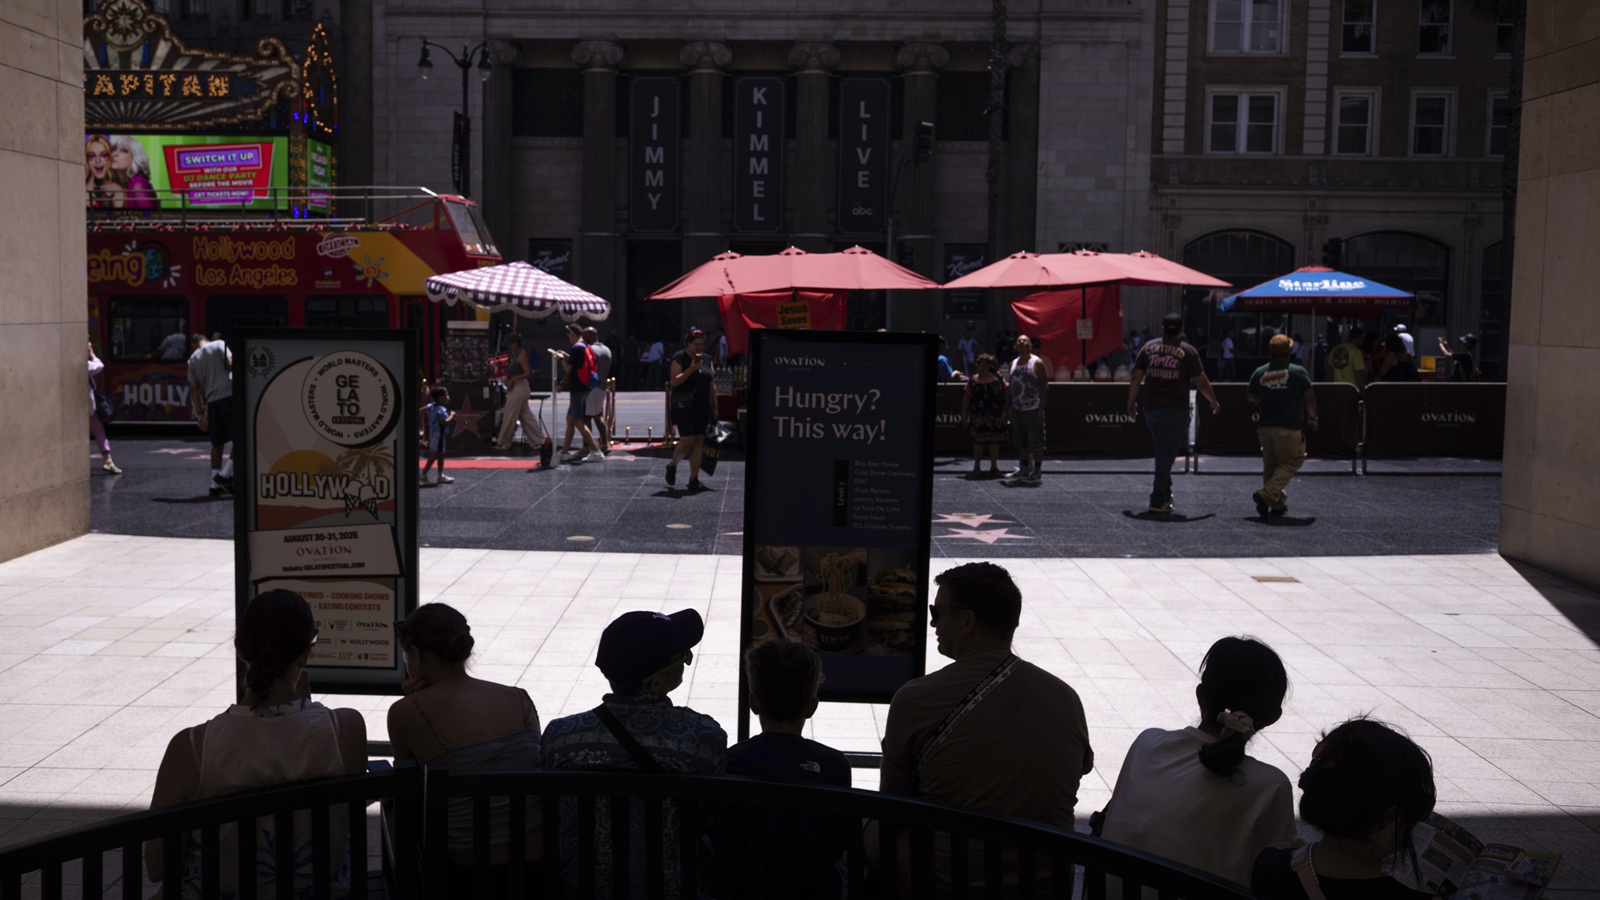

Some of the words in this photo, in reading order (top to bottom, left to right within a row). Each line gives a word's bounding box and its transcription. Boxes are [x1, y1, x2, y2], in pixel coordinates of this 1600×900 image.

[645, 95, 664, 210] JIMMY
[856, 100, 872, 188] LIVE
[185, 154, 225, 165] SWITCH
[227, 153, 237, 161] IT
[240, 152, 254, 161] UP
[749, 87, 769, 221] KIMMEL
[197, 173, 226, 181] DANCE
[229, 172, 257, 180] PARTY
[852, 204, 873, 216] abc
[193, 235, 296, 263] Hollywood
[195, 264, 227, 286] Los
[229, 263, 298, 289] Angeles
[778, 304, 808, 315] Jesus
[780, 316, 808, 325] Saves
[317, 358, 343, 376] WORLD
[345, 357, 379, 377] MASTERS
[774, 354, 826, 366] OVATION
[123, 382, 190, 407] HOLLY
[308, 384, 320, 421] MASTERS
[380, 384, 389, 413] WORLD
[775, 386, 881, 414] Hungry?
[332, 416, 365, 425] FESTIVAL
[1085, 409, 1136, 423] OVATION
[1421, 409, 1476, 423] OVATION
[318, 420, 344, 439] WORLD
[354, 413, 384, 439] MASTERS
[773, 416, 825, 439] This
[832, 419, 886, 445] way!
[261, 472, 390, 500] HOLLYWD
[837, 487, 845, 506] Level
[284, 534, 314, 543] AUGUST
[314, 532, 339, 541] 30-31,
[338, 531, 359, 540] 2025
[296, 542, 352, 556] OVATION
[304, 561, 365, 571] GELATOFESTIVAL.COM
[331, 592, 363, 600] COOKING
[319, 602, 344, 610] EATING
[344, 603, 382, 611] CONTESTS
